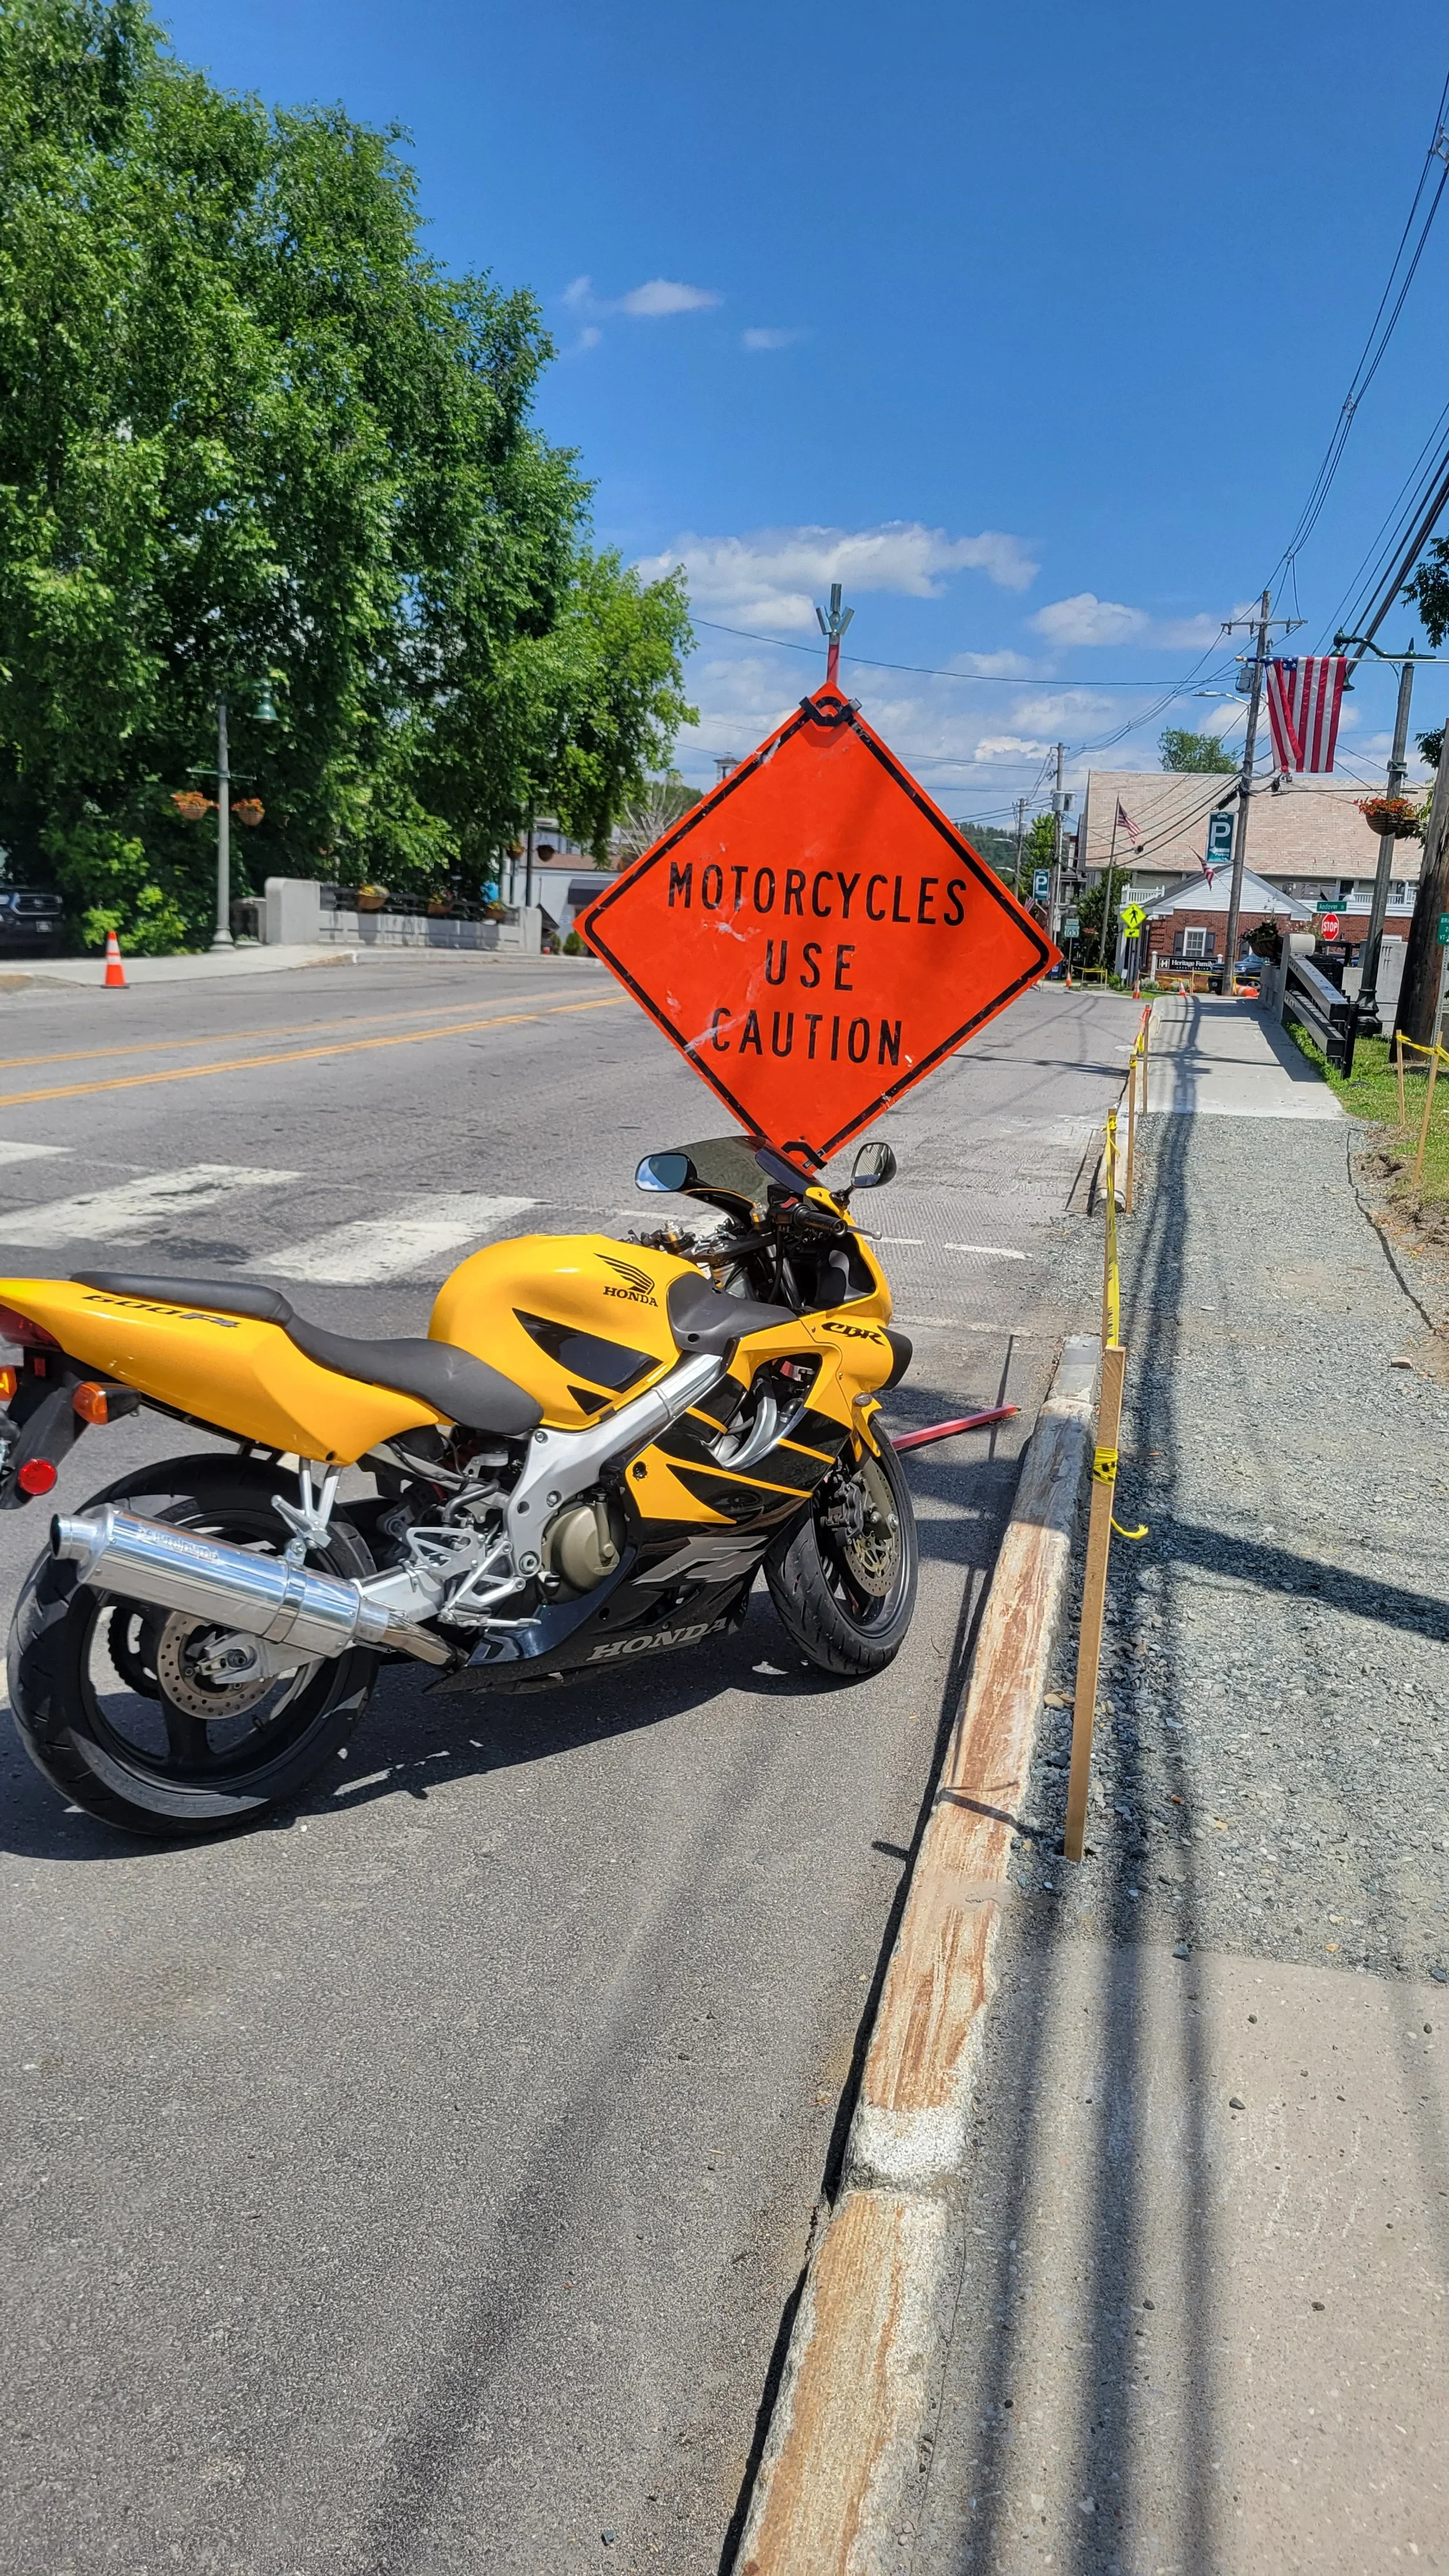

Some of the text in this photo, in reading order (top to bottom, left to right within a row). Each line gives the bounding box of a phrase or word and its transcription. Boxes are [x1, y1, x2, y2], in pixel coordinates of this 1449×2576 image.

[1210, 822, 1230, 847] P
[668, 861, 967, 926] MOTORCYCLES
[1035, 875, 1047, 892] P
[1323, 922, 1338, 932] STOP
[765, 939, 855, 991] USE
[1172, 959, 1194, 967] Heritage
[712, 1007, 902, 1066] CAUTION
[603, 1286, 658, 1307] HONDA
[821, 1322, 886, 1347] CBR
[586, 1618, 727, 1661] HONDA
